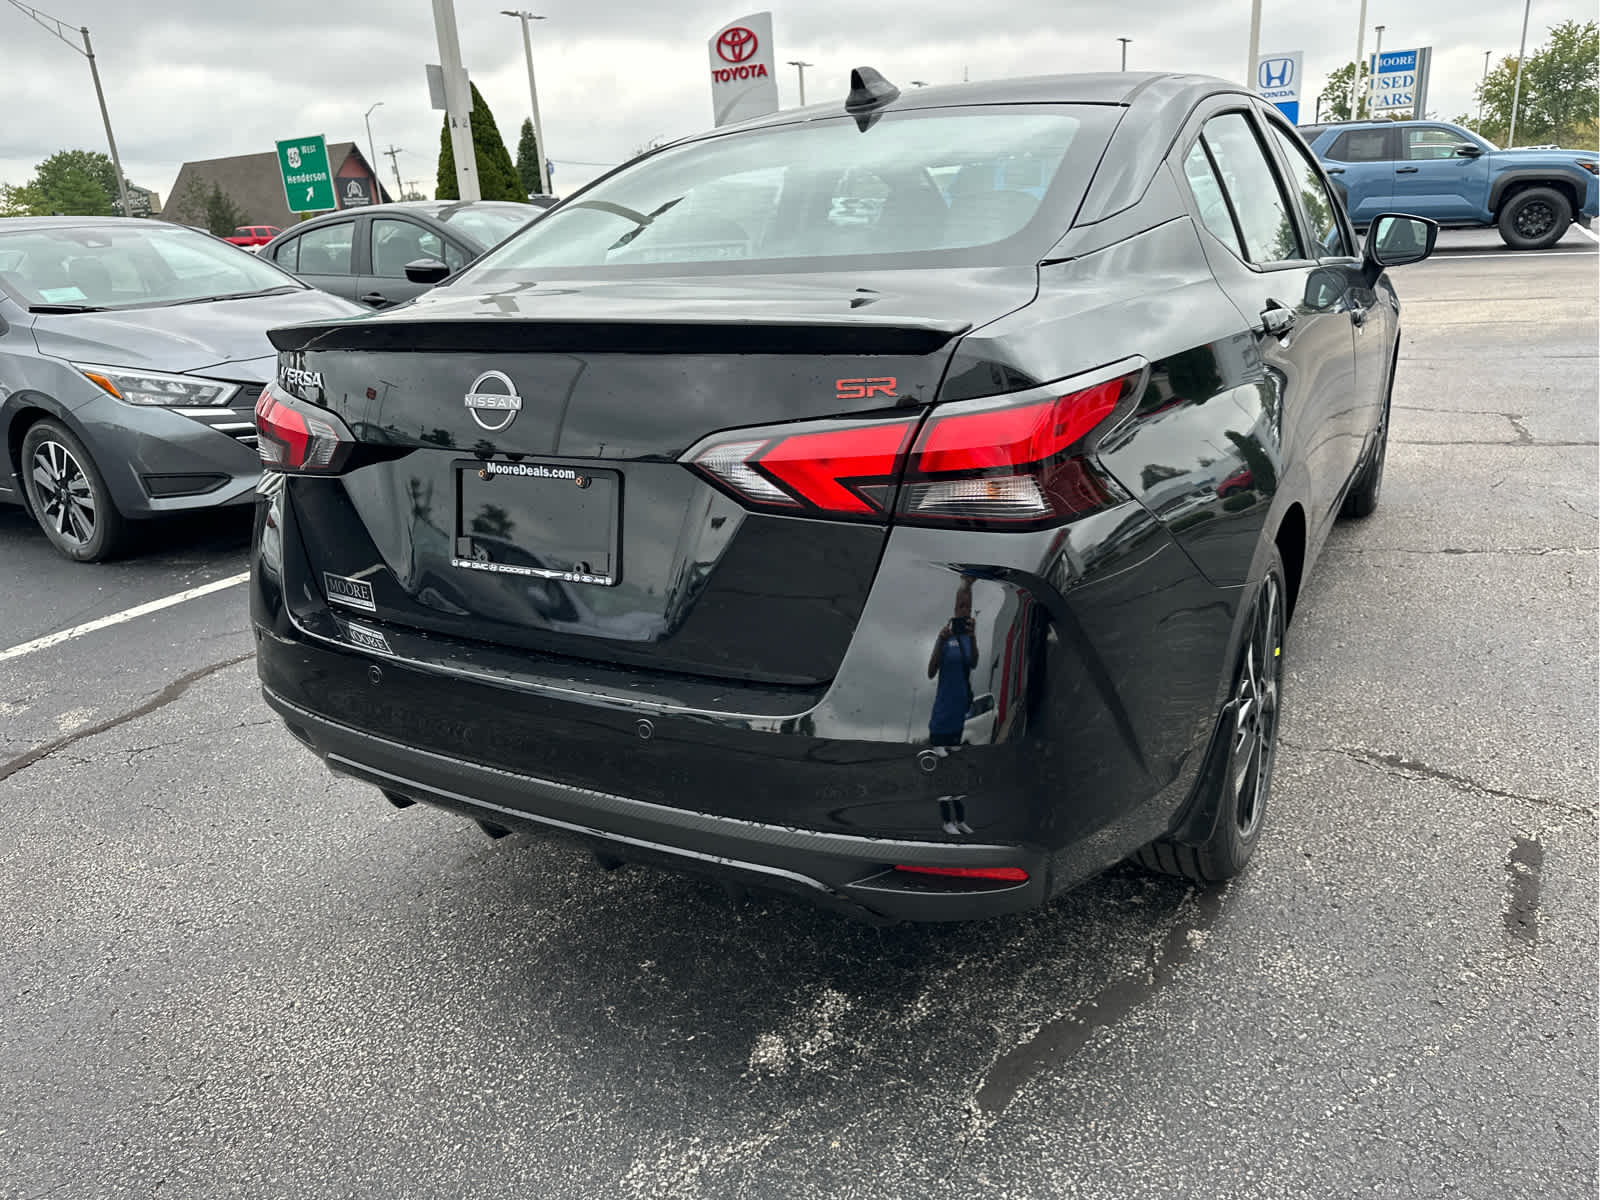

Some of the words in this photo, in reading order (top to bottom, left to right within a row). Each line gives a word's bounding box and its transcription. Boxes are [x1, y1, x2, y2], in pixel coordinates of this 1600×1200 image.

[712, 64, 768, 83] TOYOTA
[1370, 75, 1414, 90] USED
[1368, 92, 1412, 107] CARS
[289, 151, 300, 165] 60
[287, 172, 327, 184] Henderson
[280, 366, 324, 390] VERSA
[835, 376, 898, 399] SR
[464, 396, 521, 409] NISSAN
[486, 462, 576, 480] MooreDeals.com
[328, 578, 370, 600] MOORE
